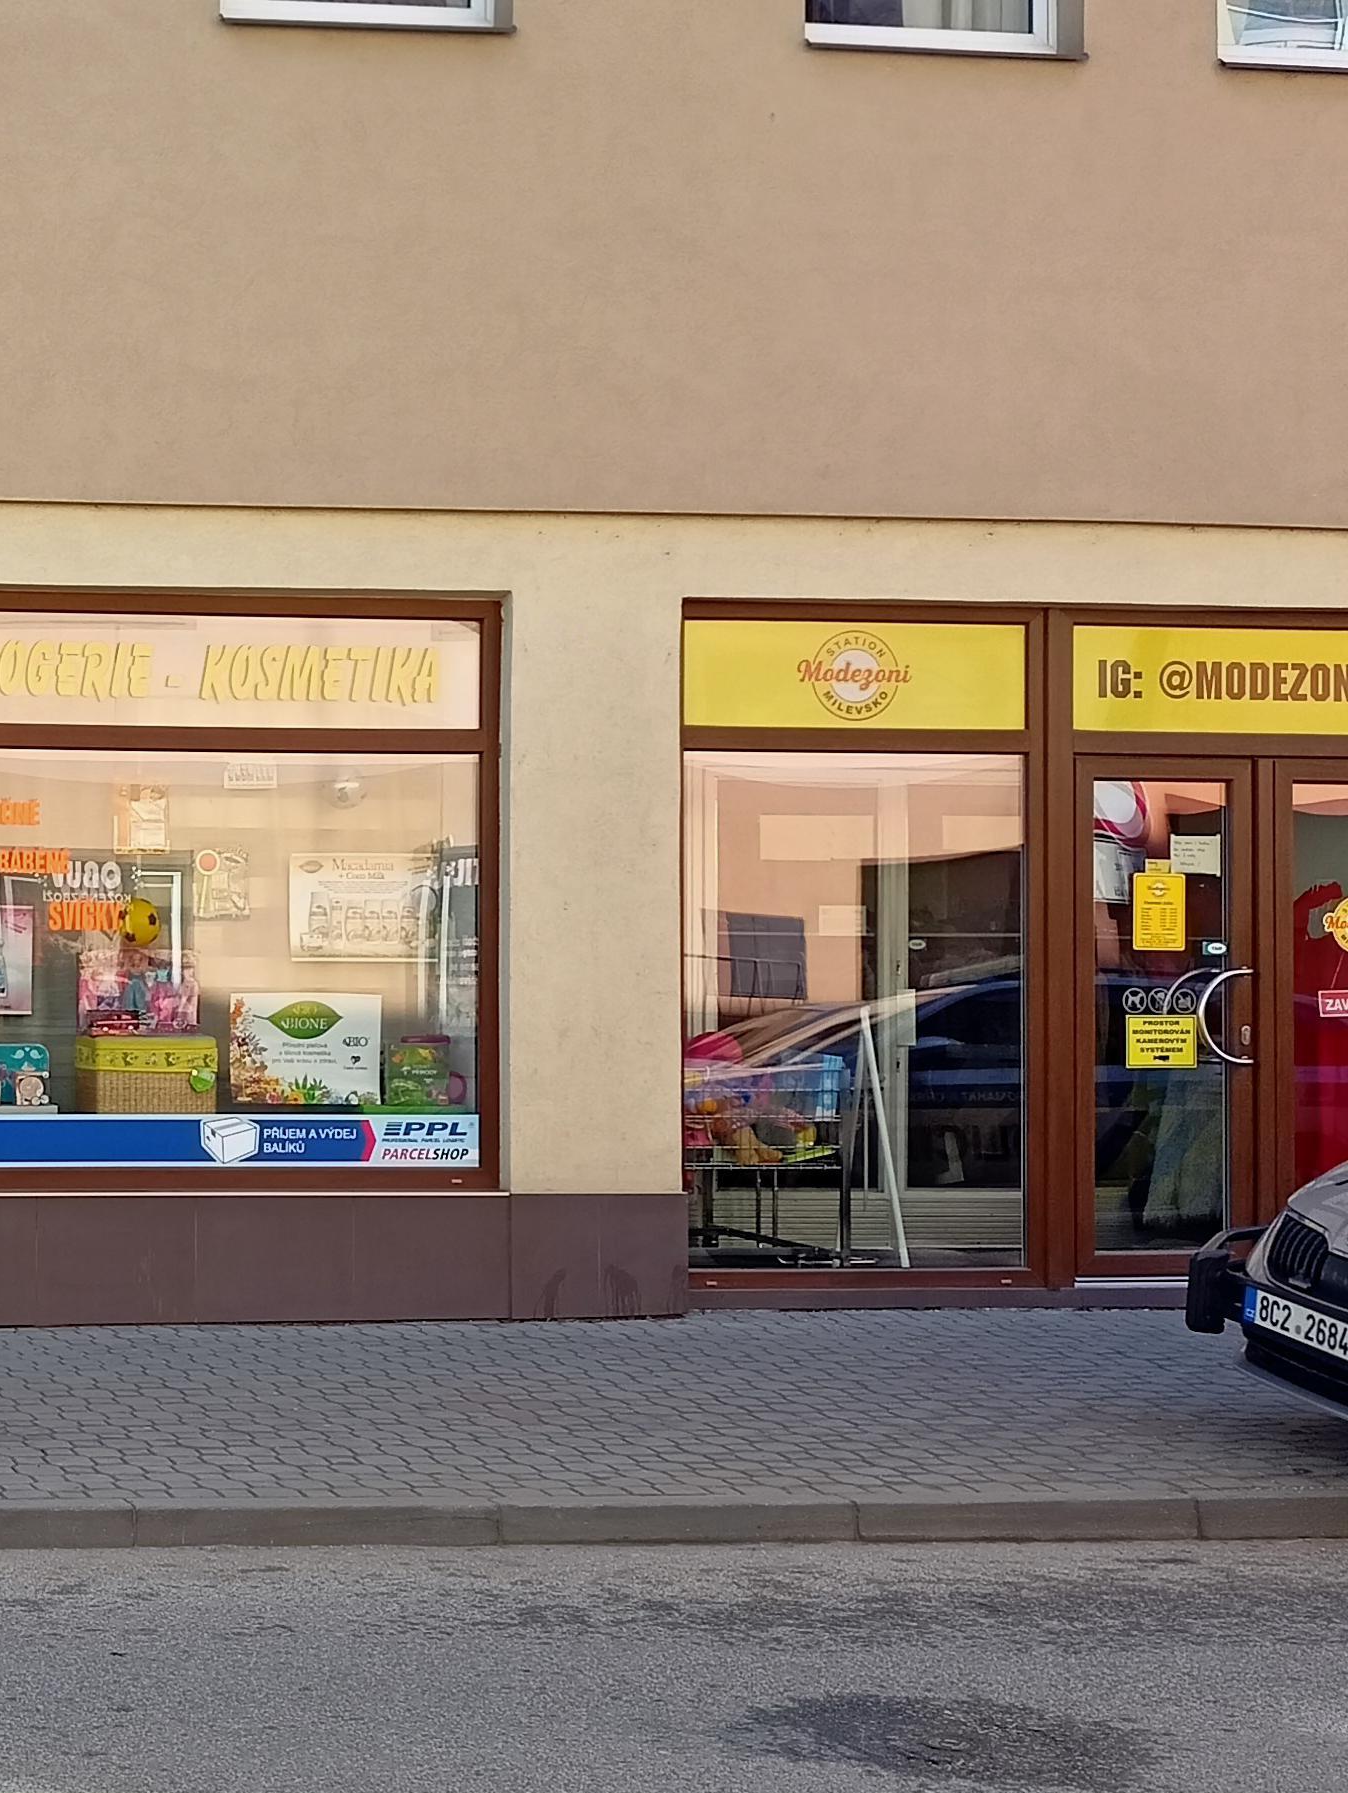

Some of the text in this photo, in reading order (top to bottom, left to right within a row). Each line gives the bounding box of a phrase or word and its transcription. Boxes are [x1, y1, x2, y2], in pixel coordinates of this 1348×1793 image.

[826, 635, 887, 660] STATION
[199, 642, 443, 707] KOSMETIKA
[796, 658, 912, 692] Modezoni
[1097, 659, 1348, 703] IG: @MODEZON
[822, 690, 889, 716] MILEVSKO
[280, 1017, 329, 1030] BIONE
[263, 1126, 358, 1140] PŘÍJEM A VÝDEJ
[402, 1121, 469, 1137] PPL
[263, 1140, 306, 1154] BALÍKŮ
[381, 1147, 470, 1161] PARCELSHOP
[1258, 1294, 1348, 1356] 8C2 2684
